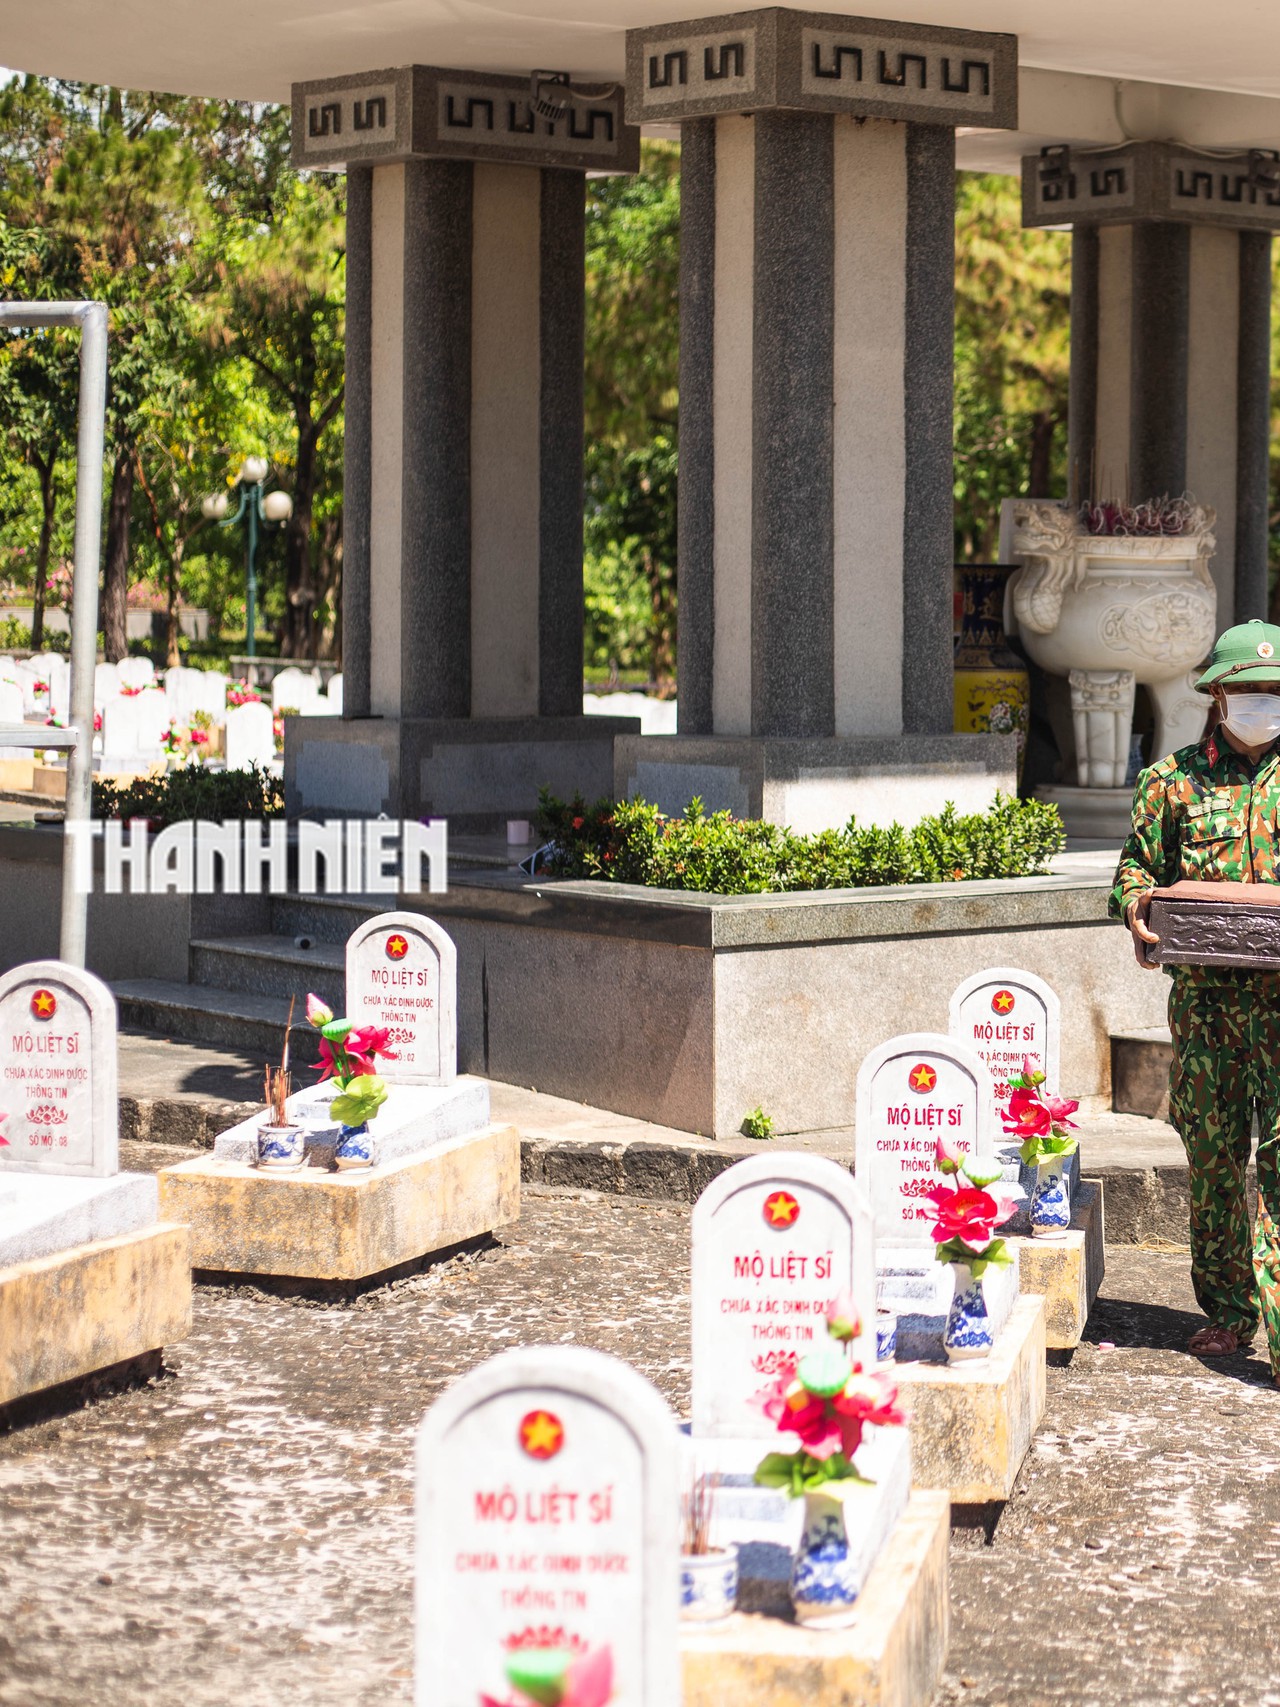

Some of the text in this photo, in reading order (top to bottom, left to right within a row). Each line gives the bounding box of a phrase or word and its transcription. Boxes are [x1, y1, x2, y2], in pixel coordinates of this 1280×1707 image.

[372, 967, 428, 989] MỘ LIỆT SĨ
[364, 995, 433, 1011] CHƯA XÁC ĐỊNH ĐƯỢC
[381, 1010, 416, 1022] THÔNG TIN
[974, 1021, 1035, 1044] MỘ LIỆT SĨ
[12, 1031, 79, 1058] MỘ LIỆT SĨ
[408, 1053, 414, 1061] 02
[1003, 1053, 1020, 1064] ĐỊNH
[4, 1067, 25, 1079] CHƯA
[29, 1065, 44, 1079] XÁC
[67, 1067, 88, 1084] ĐƯỢC
[26, 1084, 67, 1098] THÔNG TIN
[887, 1103, 963, 1131] MỘ LIỆT SĨ
[29, 1130, 38, 1145] SỐ
[42, 1132, 52, 1150] MỘ
[877, 1139, 900, 1152] CHƯA
[904, 1138, 922, 1152] XÁC
[924, 1141, 937, 1156] ĐỊN
[901, 1157, 930, 1172] THÔNG
[902, 1203, 913, 1219] SỐ
[734, 1250, 833, 1285] MỘ LIỆT SĨ
[721, 1298, 751, 1313] CHƯA
[755, 1295, 779, 1314] XÁC
[752, 1322, 813, 1340] THÔNG TIN
[475, 1485, 516, 1533] MỘ
[525, 1486, 579, 1532] LIỆT
